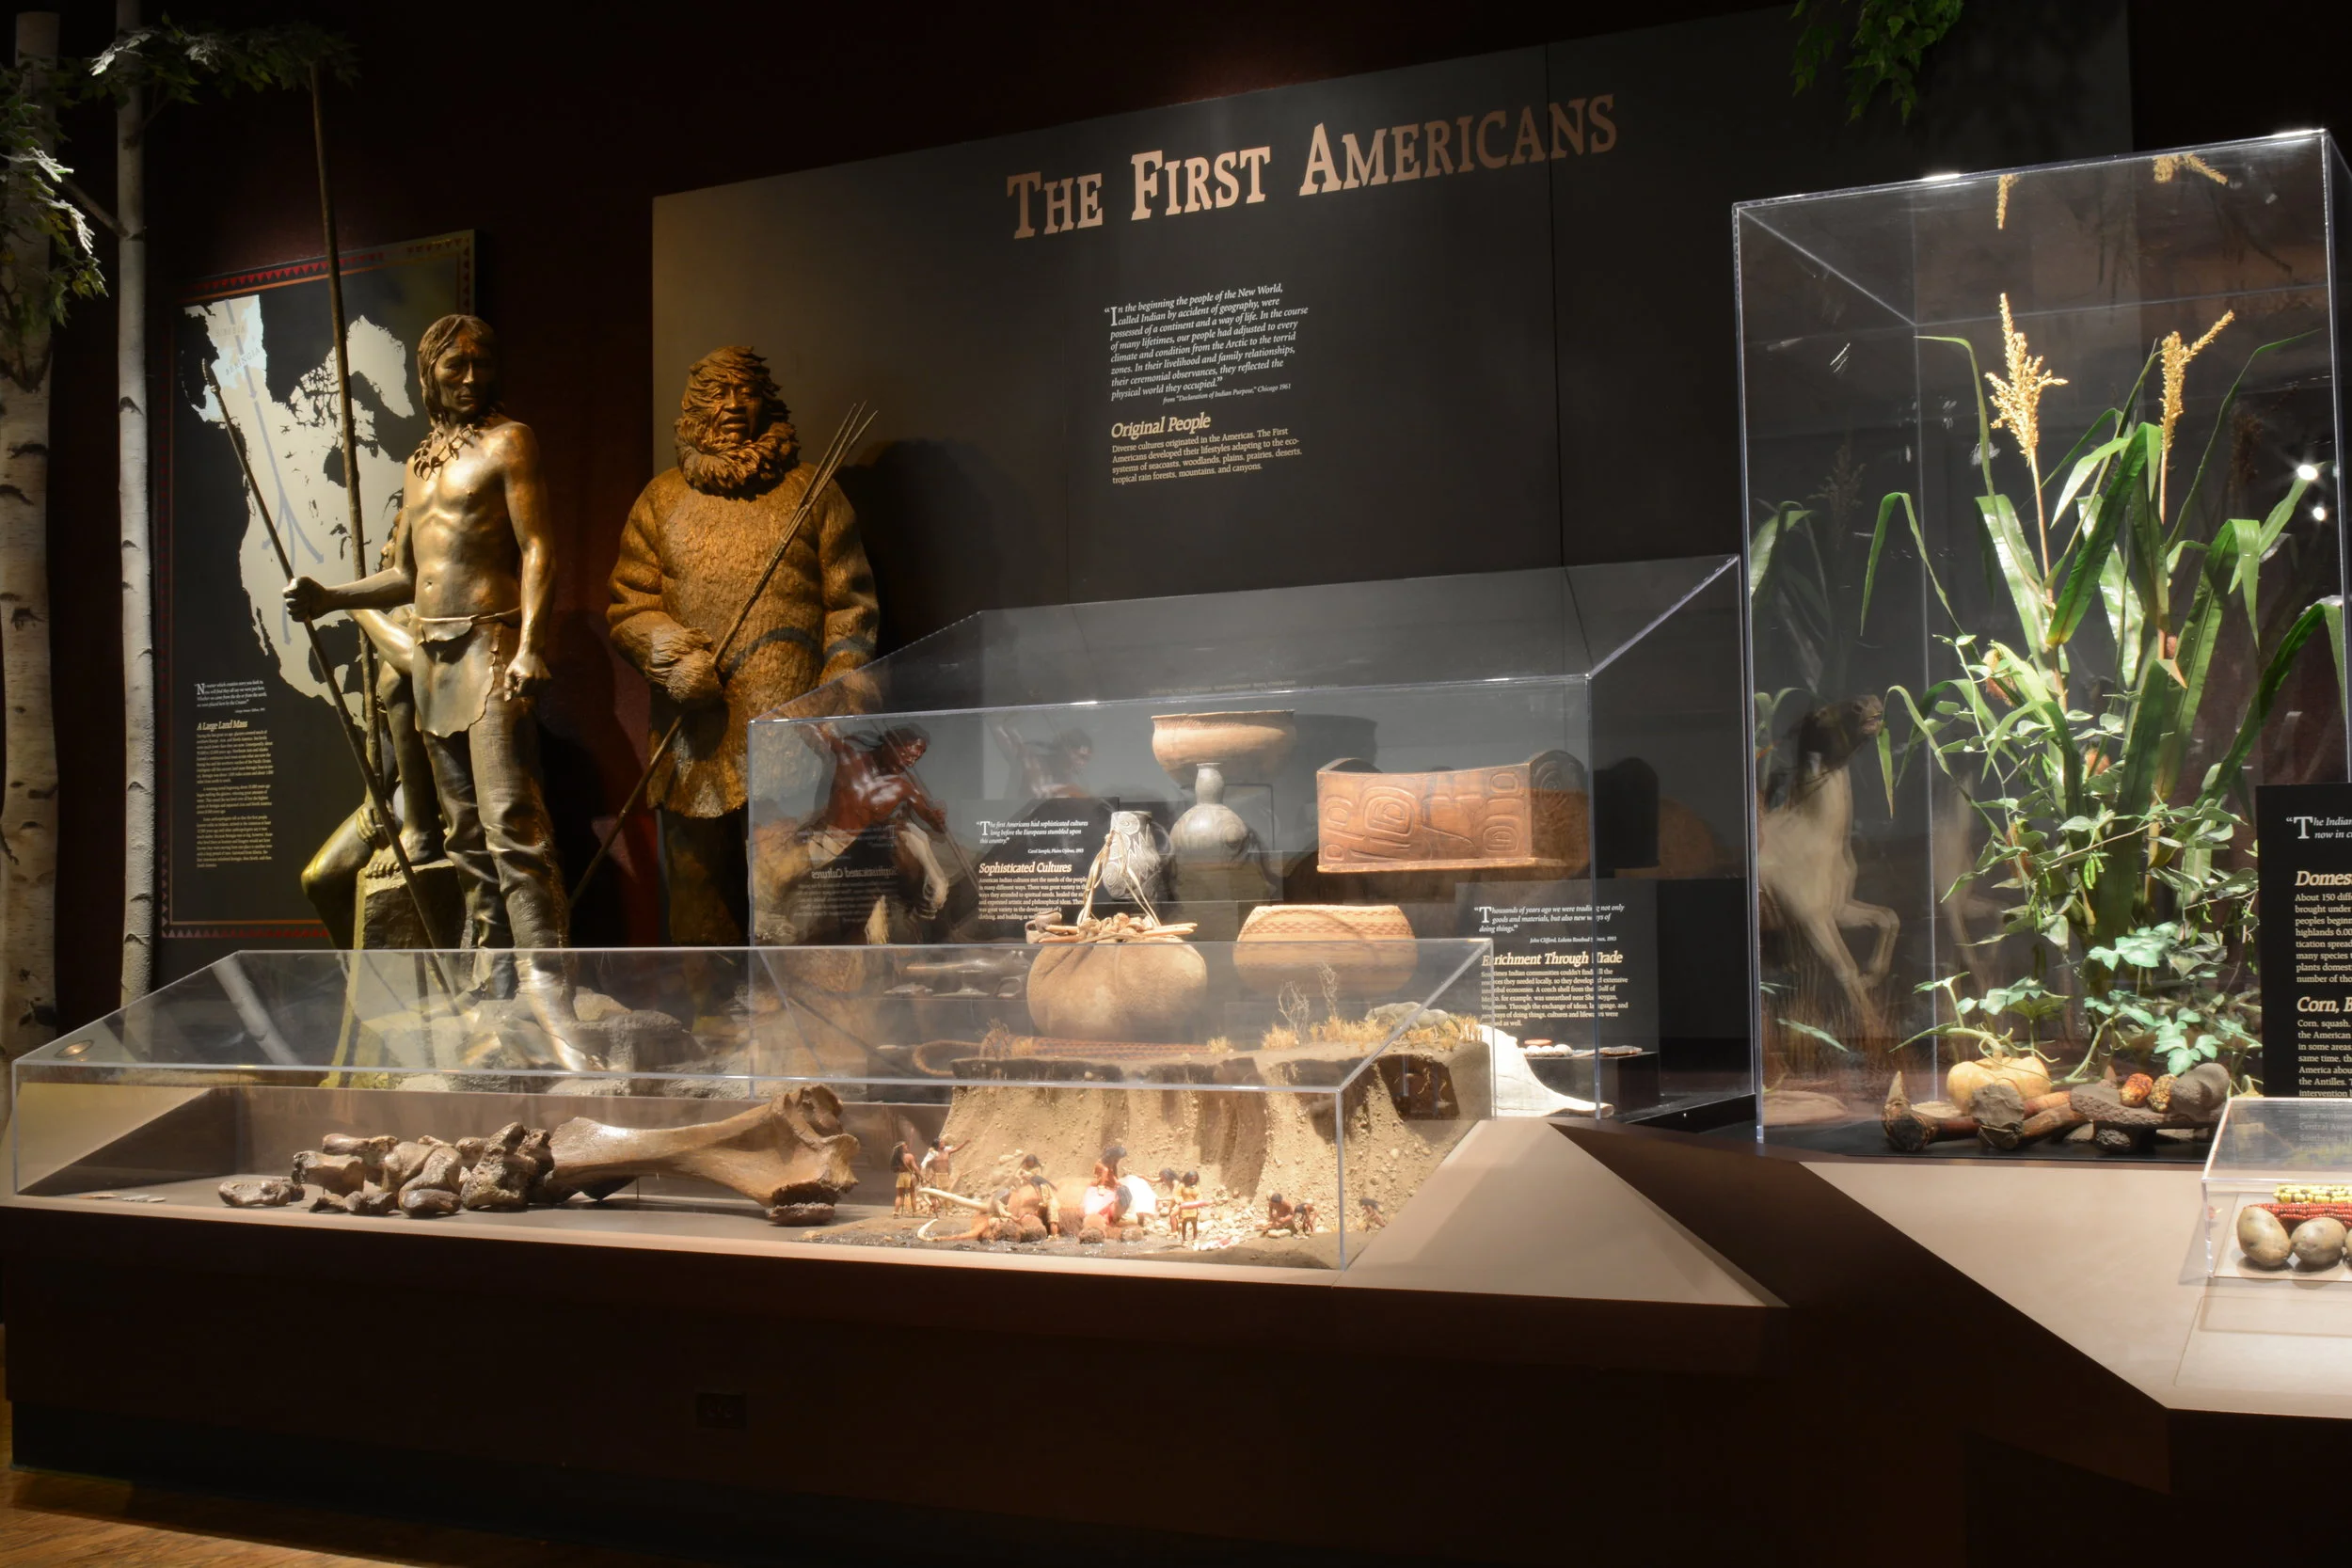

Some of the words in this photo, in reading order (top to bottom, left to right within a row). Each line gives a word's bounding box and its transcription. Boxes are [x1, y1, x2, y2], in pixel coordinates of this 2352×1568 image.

[1007, 171, 1105, 239] THE
[1131, 145, 1272, 222] FIRST
[1298, 94, 1617, 196] AMERICANS
[1125, 303, 1137, 313] the
[1137, 298, 1175, 312] beginning
[1176, 296, 1188, 306] the
[1188, 293, 1214, 307] people
[1215, 291, 1224, 303] of
[1224, 290, 1236, 299] the
[1237, 288, 1256, 298] New
[1257, 283, 1283, 294] World,
[1118, 314, 1140, 325] called
[1141, 312, 1166, 323] Indian
[1167, 309, 1177, 321] by
[1178, 306, 1210, 318] accident
[1210, 303, 1220, 316] of
[1218, 299, 1260, 315] geography,
[1262, 298, 1280, 307] were
[1110, 325, 1143, 341] possessed
[1144, 324, 1153, 336] of
[1159, 321, 1195, 332] continent
[1195, 317, 1211, 327] and
[1218, 317, 1234, 325] way
[1235, 312, 1245, 325] of
[1244, 311, 1258, 324] life.
[1260, 310, 1268, 320] In
[1270, 309, 1283, 318] the
[1283, 308, 1309, 317] course
[1110, 341, 1120, 353] of
[1120, 341, 1141, 350] many
[1141, 336, 1175, 349] lifetimes,
[1176, 334, 1190, 342] our
[1191, 329, 1216, 343] people
[1216, 326, 1232, 337] had
[1233, 322, 1266, 337] adjusted
[1277, 321, 1298, 330] every
[1110, 353, 1138, 363] climate
[1138, 348, 1154, 359] and
[1154, 345, 1190, 357] condition
[1191, 343, 1210, 356] from
[1212, 341, 1224, 350] the
[1225, 338, 1248, 349] Arctic
[1259, 335, 1272, 344] the
[1273, 331, 1296, 342] torrid
[1111, 366, 1133, 374] zones.
[1135, 363, 1143, 372] In
[1144, 360, 1163, 371] their
[1164, 355, 1200, 369] livelihood
[1201, 353, 1217, 364] and
[1217, 350, 1244, 364] family
[1245, 345, 1295, 358] relationships,
[1111, 376, 1129, 387] their
[1130, 371, 1171, 385] ceremonial
[1171, 368, 1217, 380] observances,
[1219, 364, 1236, 375] they
[1238, 359, 1270, 373] reflected
[1271, 358, 1284, 368] the
[1111, 387, 1141, 402] physical
[1142, 384, 1164, 395] world
[1165, 383, 1182, 394] they
[1111, 416, 1166, 440] Original
[1167, 411, 1211, 435] People
[1112, 445, 1137, 453] Diverse
[1137, 440, 1165, 451] cultures
[1165, 436, 1200, 449] originated
[1209, 434, 1220, 443] the
[1222, 432, 1255, 441] Americas.
[1257, 429, 1271, 437] The
[1272, 428, 1288, 436] First
[1112, 453, 1147, 464] Americans
[1148, 448, 1183, 460] developed
[1183, 447, 1200, 456] their
[1200, 443, 1231, 454] lifestyles
[1232, 442, 1263, 451] adapting
[1272, 437, 1284, 447] the
[1112, 465, 1139, 475] systems
[1139, 462, 1148, 471] of
[1112, 473, 1137, 485] tropical
[1217, 464, 1232, 473] and
[1232, 463, 1263, 473] canyons.
[1040, 820, 1070, 829] sophisticated
[2335, 830, 2344, 839] in
[978, 861, 1036, 877] Sophisticated
[1036, 861, 1073, 873] Cultures
[2296, 893, 2319, 901] About
[2322, 893, 2335, 901] 150
[1518, 906, 1526, 915] of
[1611, 903, 1625, 912] only
[2295, 904, 2326, 914] brought
[2328, 904, 2351, 912] under
[1492, 915, 1508, 925] goods
[1604, 912, 1612, 922] of
[2296, 916, 2325, 927] peoples
[1479, 924, 1496, 934] doing
[1496, 924, 1518, 933] things.”
[2296, 927, 2334, 938] highlands
[1544, 951, 1589, 968] Through
[2320, 952, 2348, 961] species
[2296, 962, 2321, 973] plants
[2296, 974, 2328, 983] number
[2328, 974, 2338, 983] of
[2296, 996, 2340, 1014] Corn,
[2297, 1030, 2312, 1038] the
[2313, 1031, 2351, 1039] American
[2298, 1089, 2348, 1098] intervention
